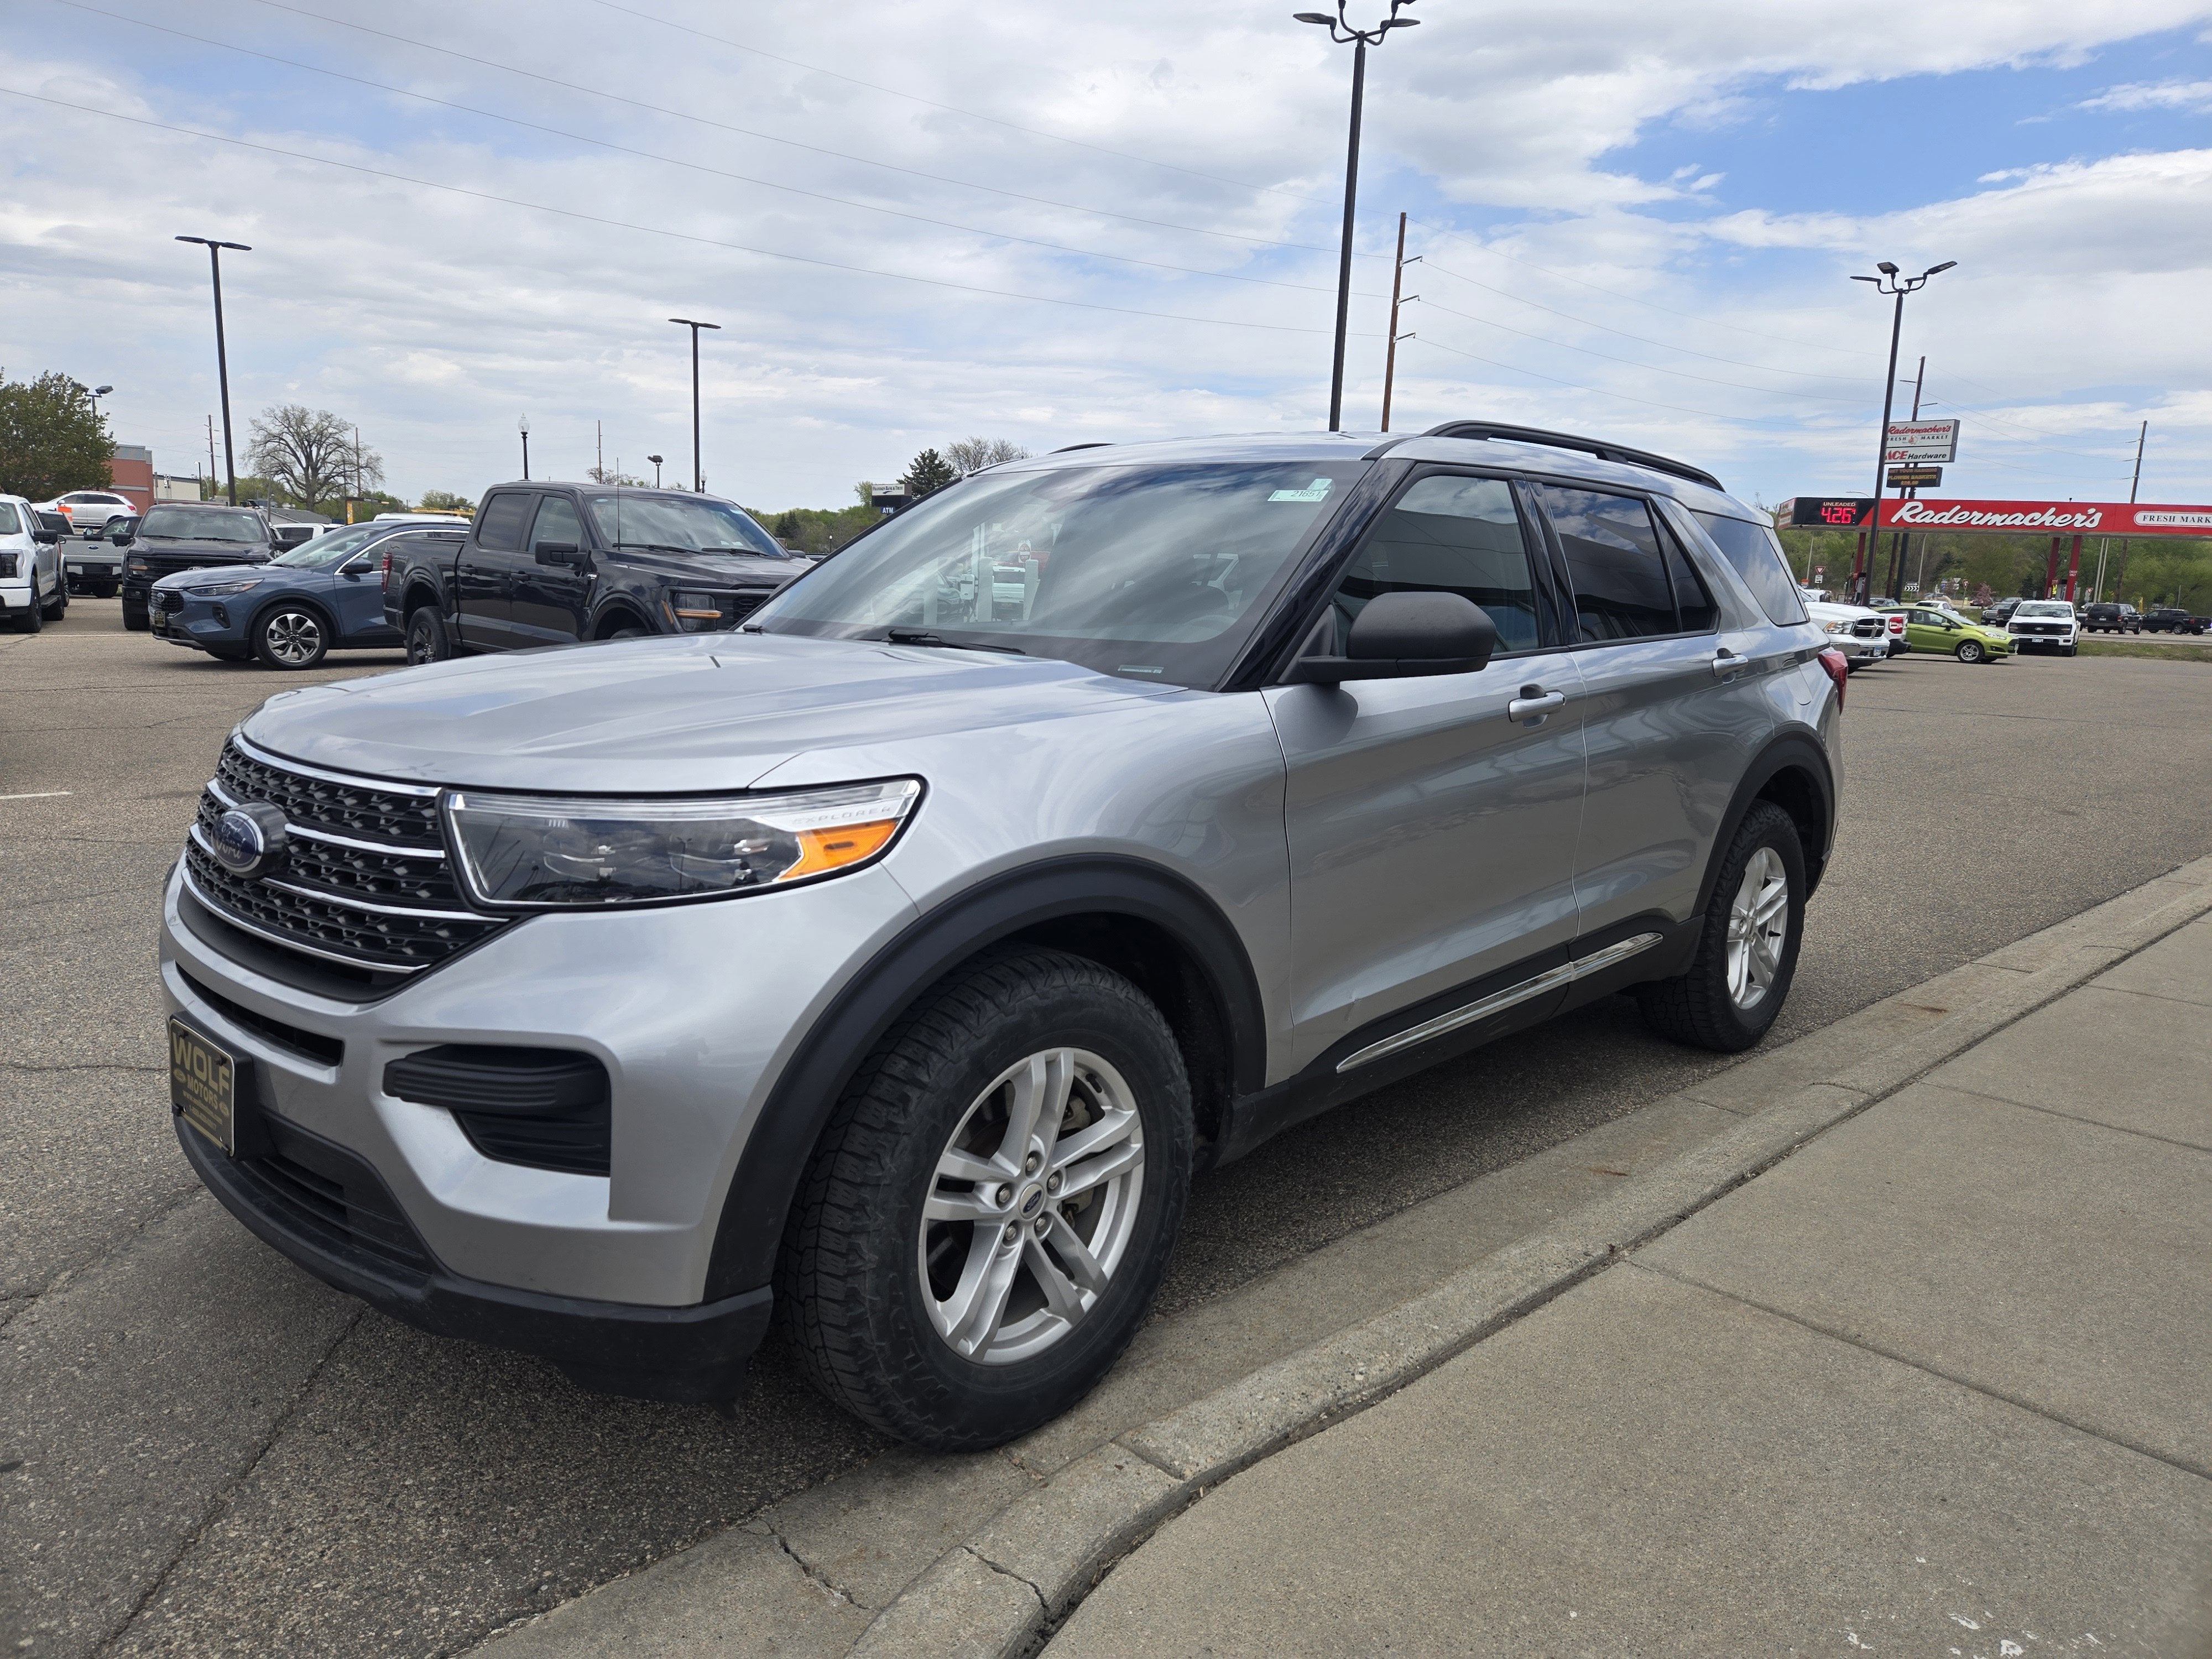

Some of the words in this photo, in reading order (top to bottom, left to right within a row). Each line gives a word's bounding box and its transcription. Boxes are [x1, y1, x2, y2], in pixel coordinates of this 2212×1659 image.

[1885, 450, 1908, 460] ACE
[1891, 501, 2103, 528] Radermacher's
[793, 806, 891, 823] EXPLORER
[172, 1032, 229, 1096] WOLF
[187, 1074, 218, 1110] MOTORS
